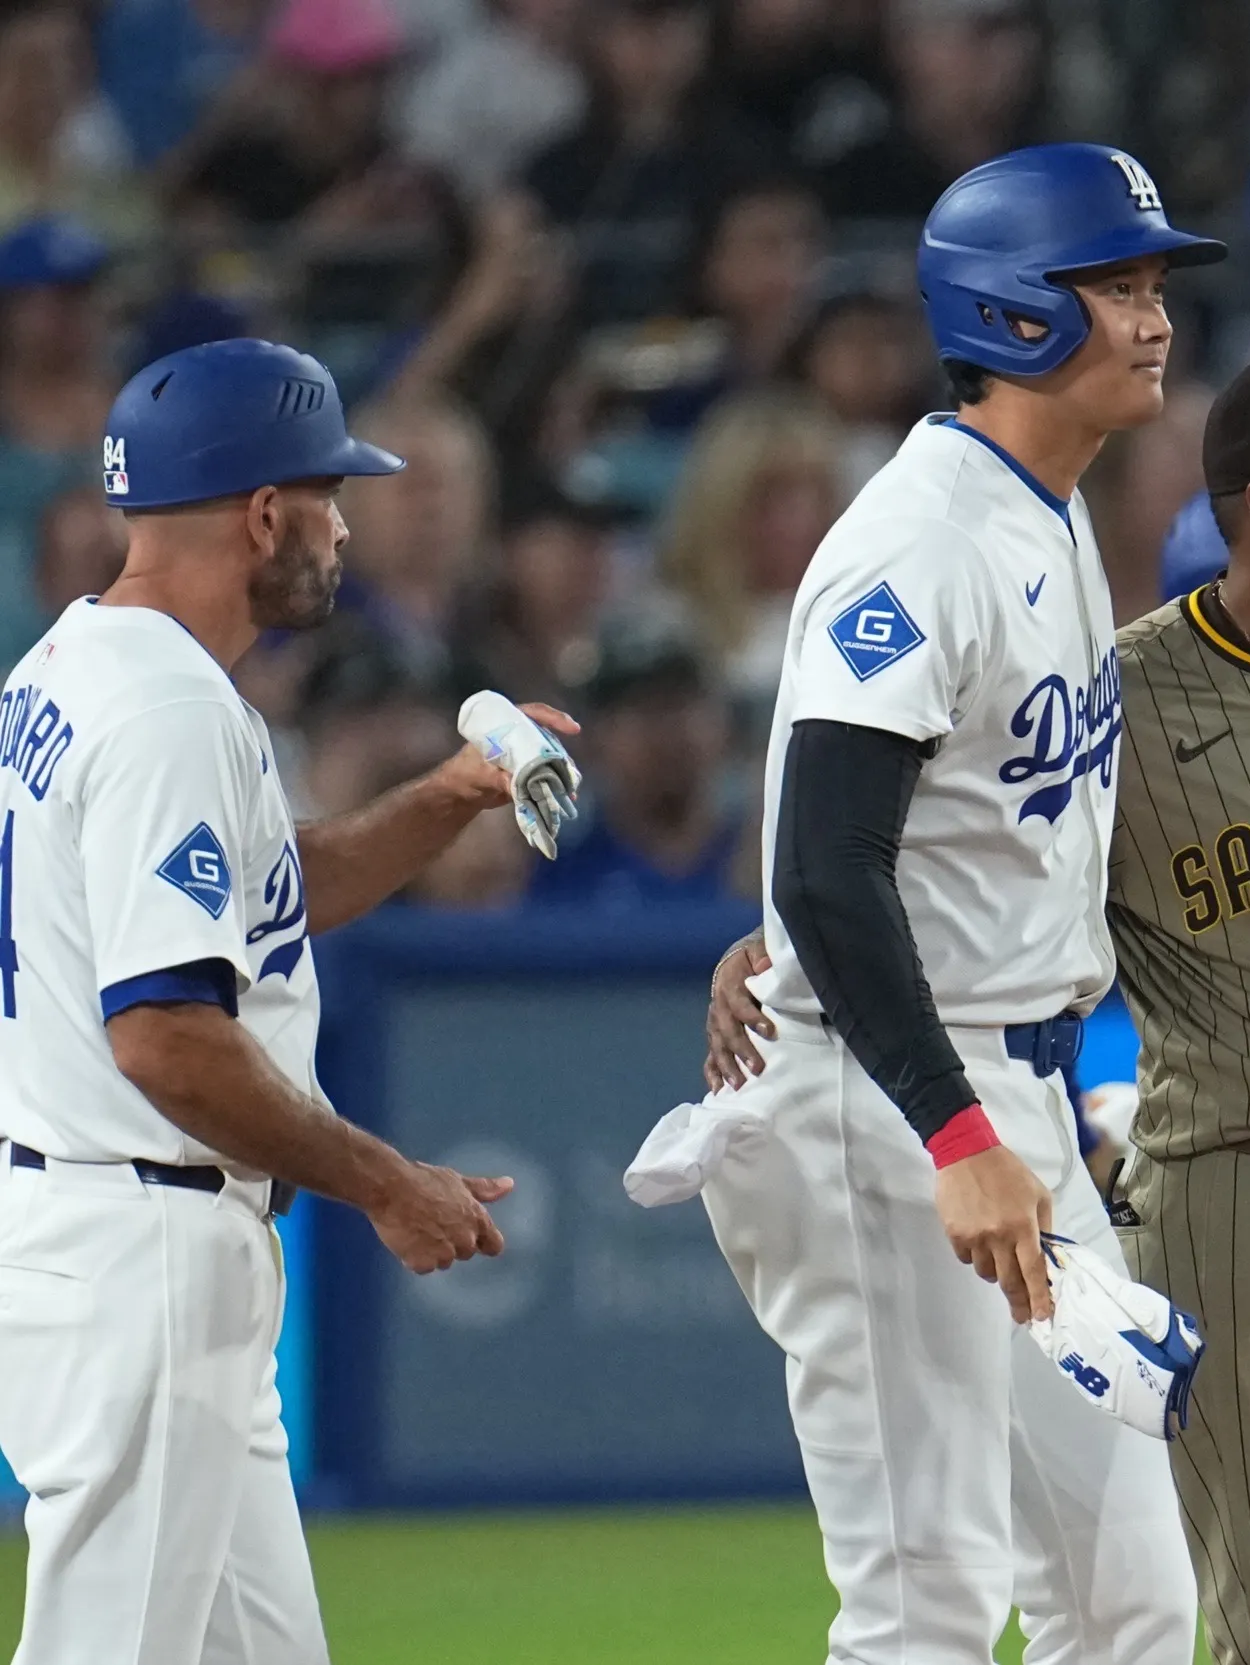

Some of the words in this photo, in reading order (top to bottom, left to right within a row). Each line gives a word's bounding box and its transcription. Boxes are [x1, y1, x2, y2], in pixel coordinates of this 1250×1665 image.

[1111, 155, 1162, 208] LA
[103, 435, 126, 472] 84
[856, 609, 895, 643] G
[189, 849, 219, 882] G
